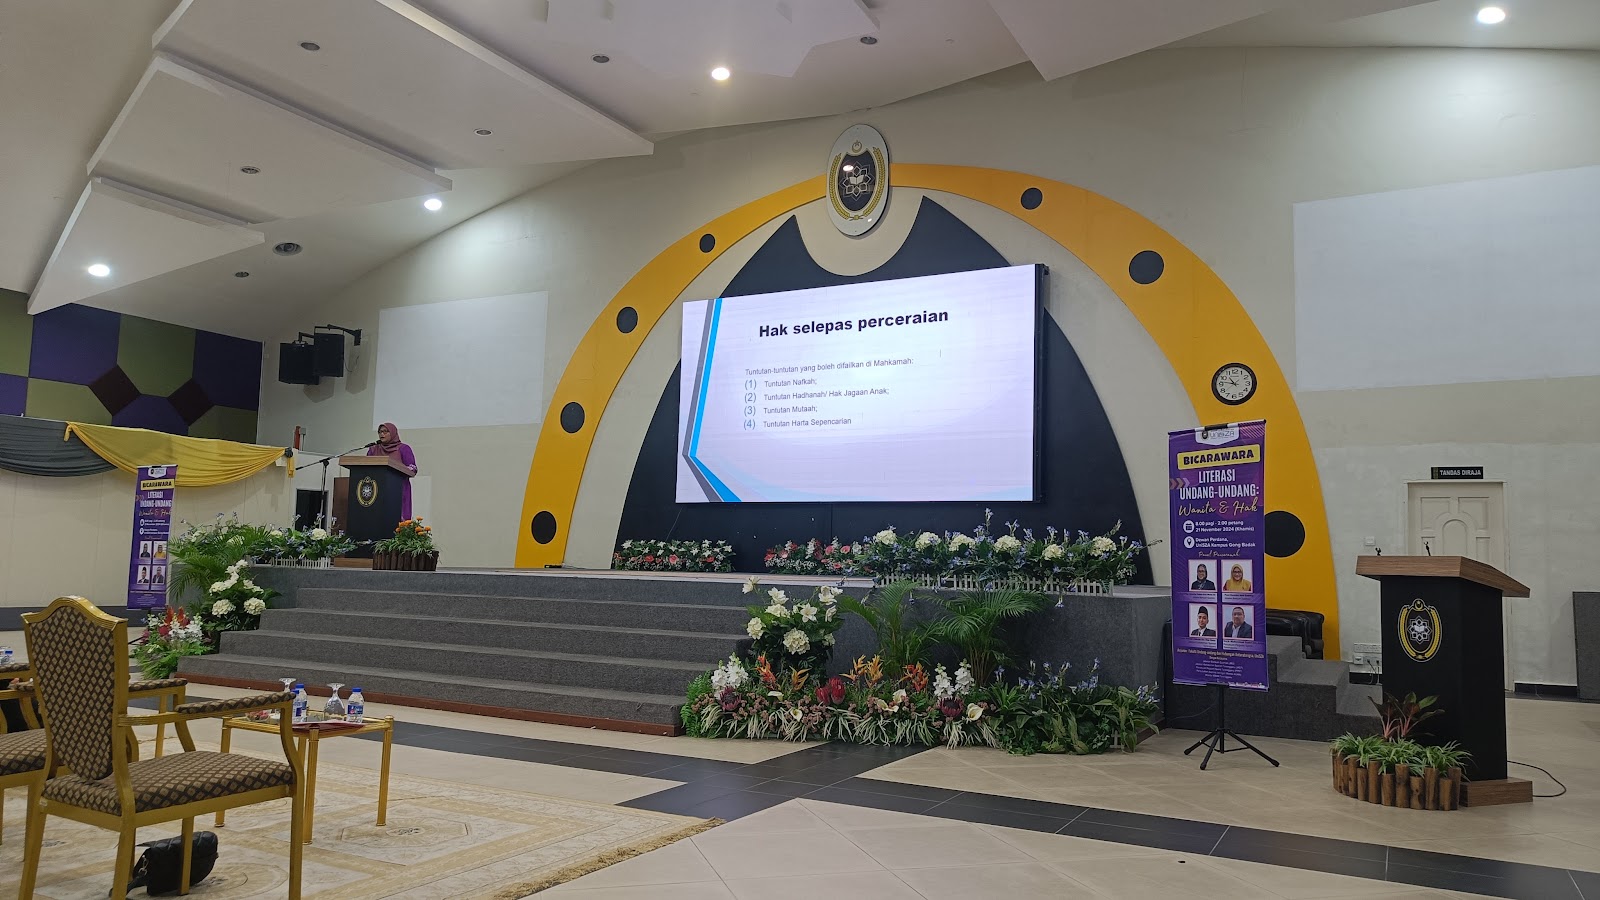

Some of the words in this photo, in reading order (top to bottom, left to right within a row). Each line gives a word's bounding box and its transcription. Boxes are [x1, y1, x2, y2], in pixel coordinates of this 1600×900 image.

[759, 324, 788, 338] Hak
[793, 320, 852, 334] selepas
[858, 310, 948, 332] perceraian
[745, 366, 798, 376] Tuntutan-tuntutan
[800, 364, 816, 373] yang
[817, 362, 835, 370] boleh
[836, 361, 864, 369] difailkan
[874, 358, 914, 366] Mahkamah:
[744, 379, 756, 390] (1)
[792, 378, 817, 386] Nafkah;
[744, 392, 756, 404] (2)
[844, 388, 868, 398] Jagaan
[744, 406, 756, 417] (3)
[744, 419, 756, 430] (4)
[810, 418, 852, 426] Sepencarian
[1183, 449, 1254, 466] BICARAWARA
[1198, 469, 1236, 484] LITERASI
[1180, 484, 1260, 500] UNDANG-UNDANG:
[1178, 501, 1216, 516] Wanita
[1219, 501, 1229, 514] &
[1232, 496, 1258, 516] Hak
